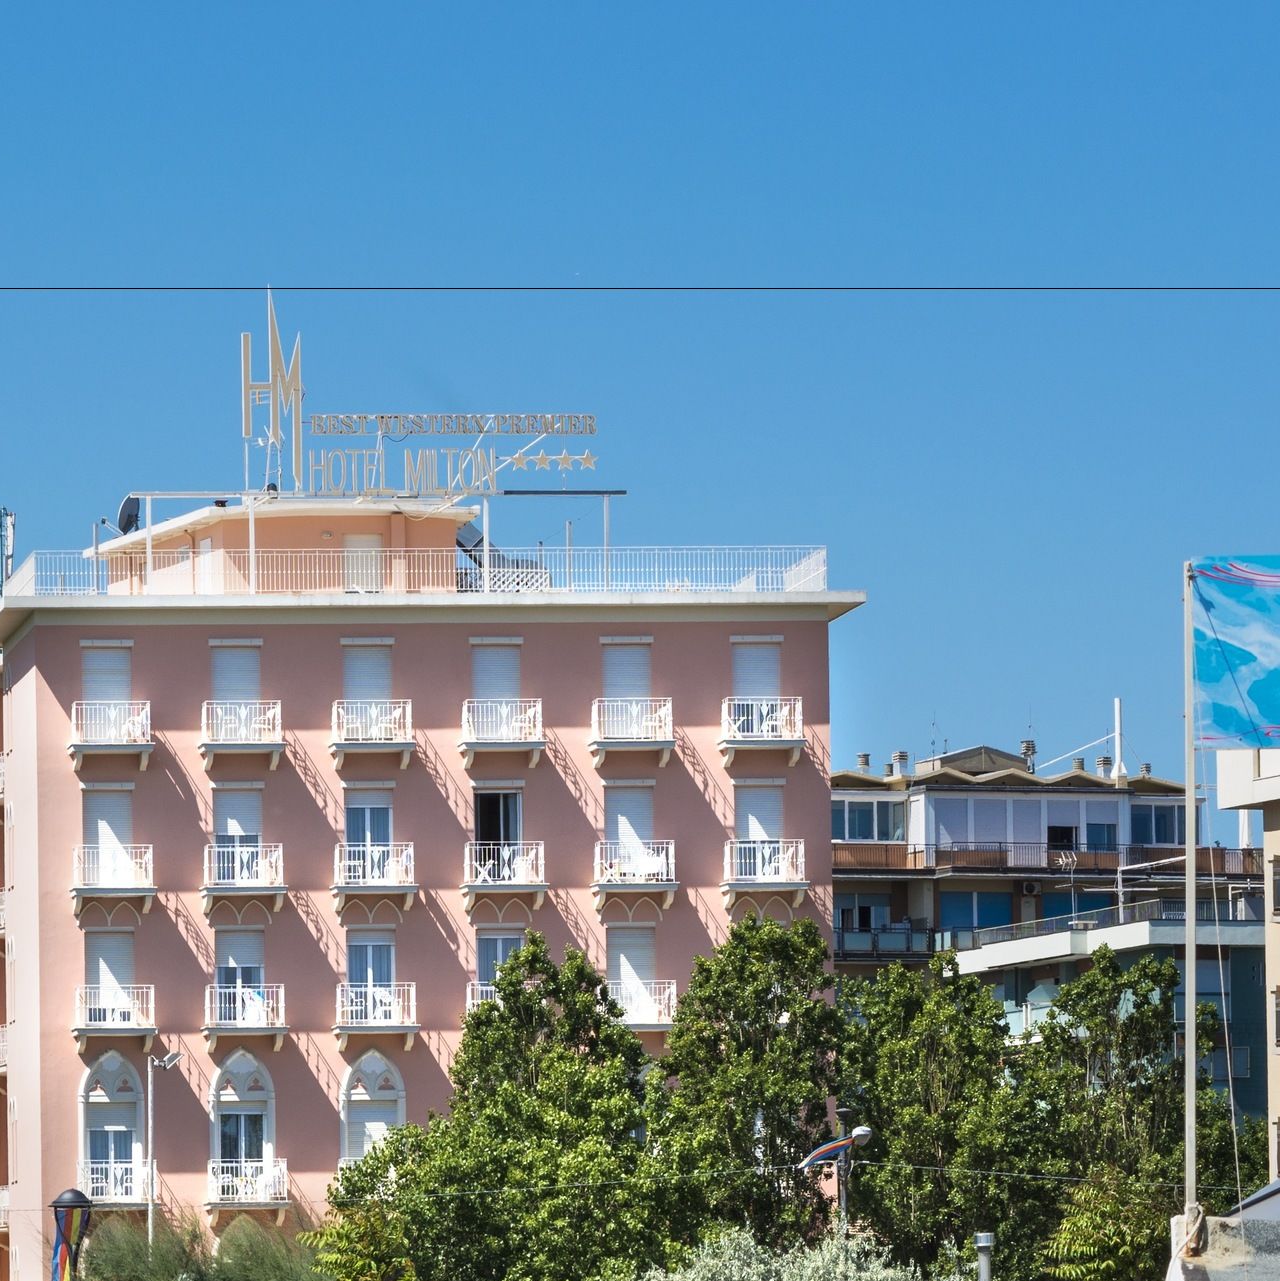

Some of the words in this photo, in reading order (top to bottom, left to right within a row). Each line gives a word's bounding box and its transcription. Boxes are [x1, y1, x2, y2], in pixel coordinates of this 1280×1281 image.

[241, 284, 303, 491] HM
[310, 414, 370, 435] BEST
[374, 414, 486, 435] WESTERN
[494, 414, 598, 435] PREMIER
[309, 448, 387, 492] HOTEL
[404, 448, 497, 492] MILTON
